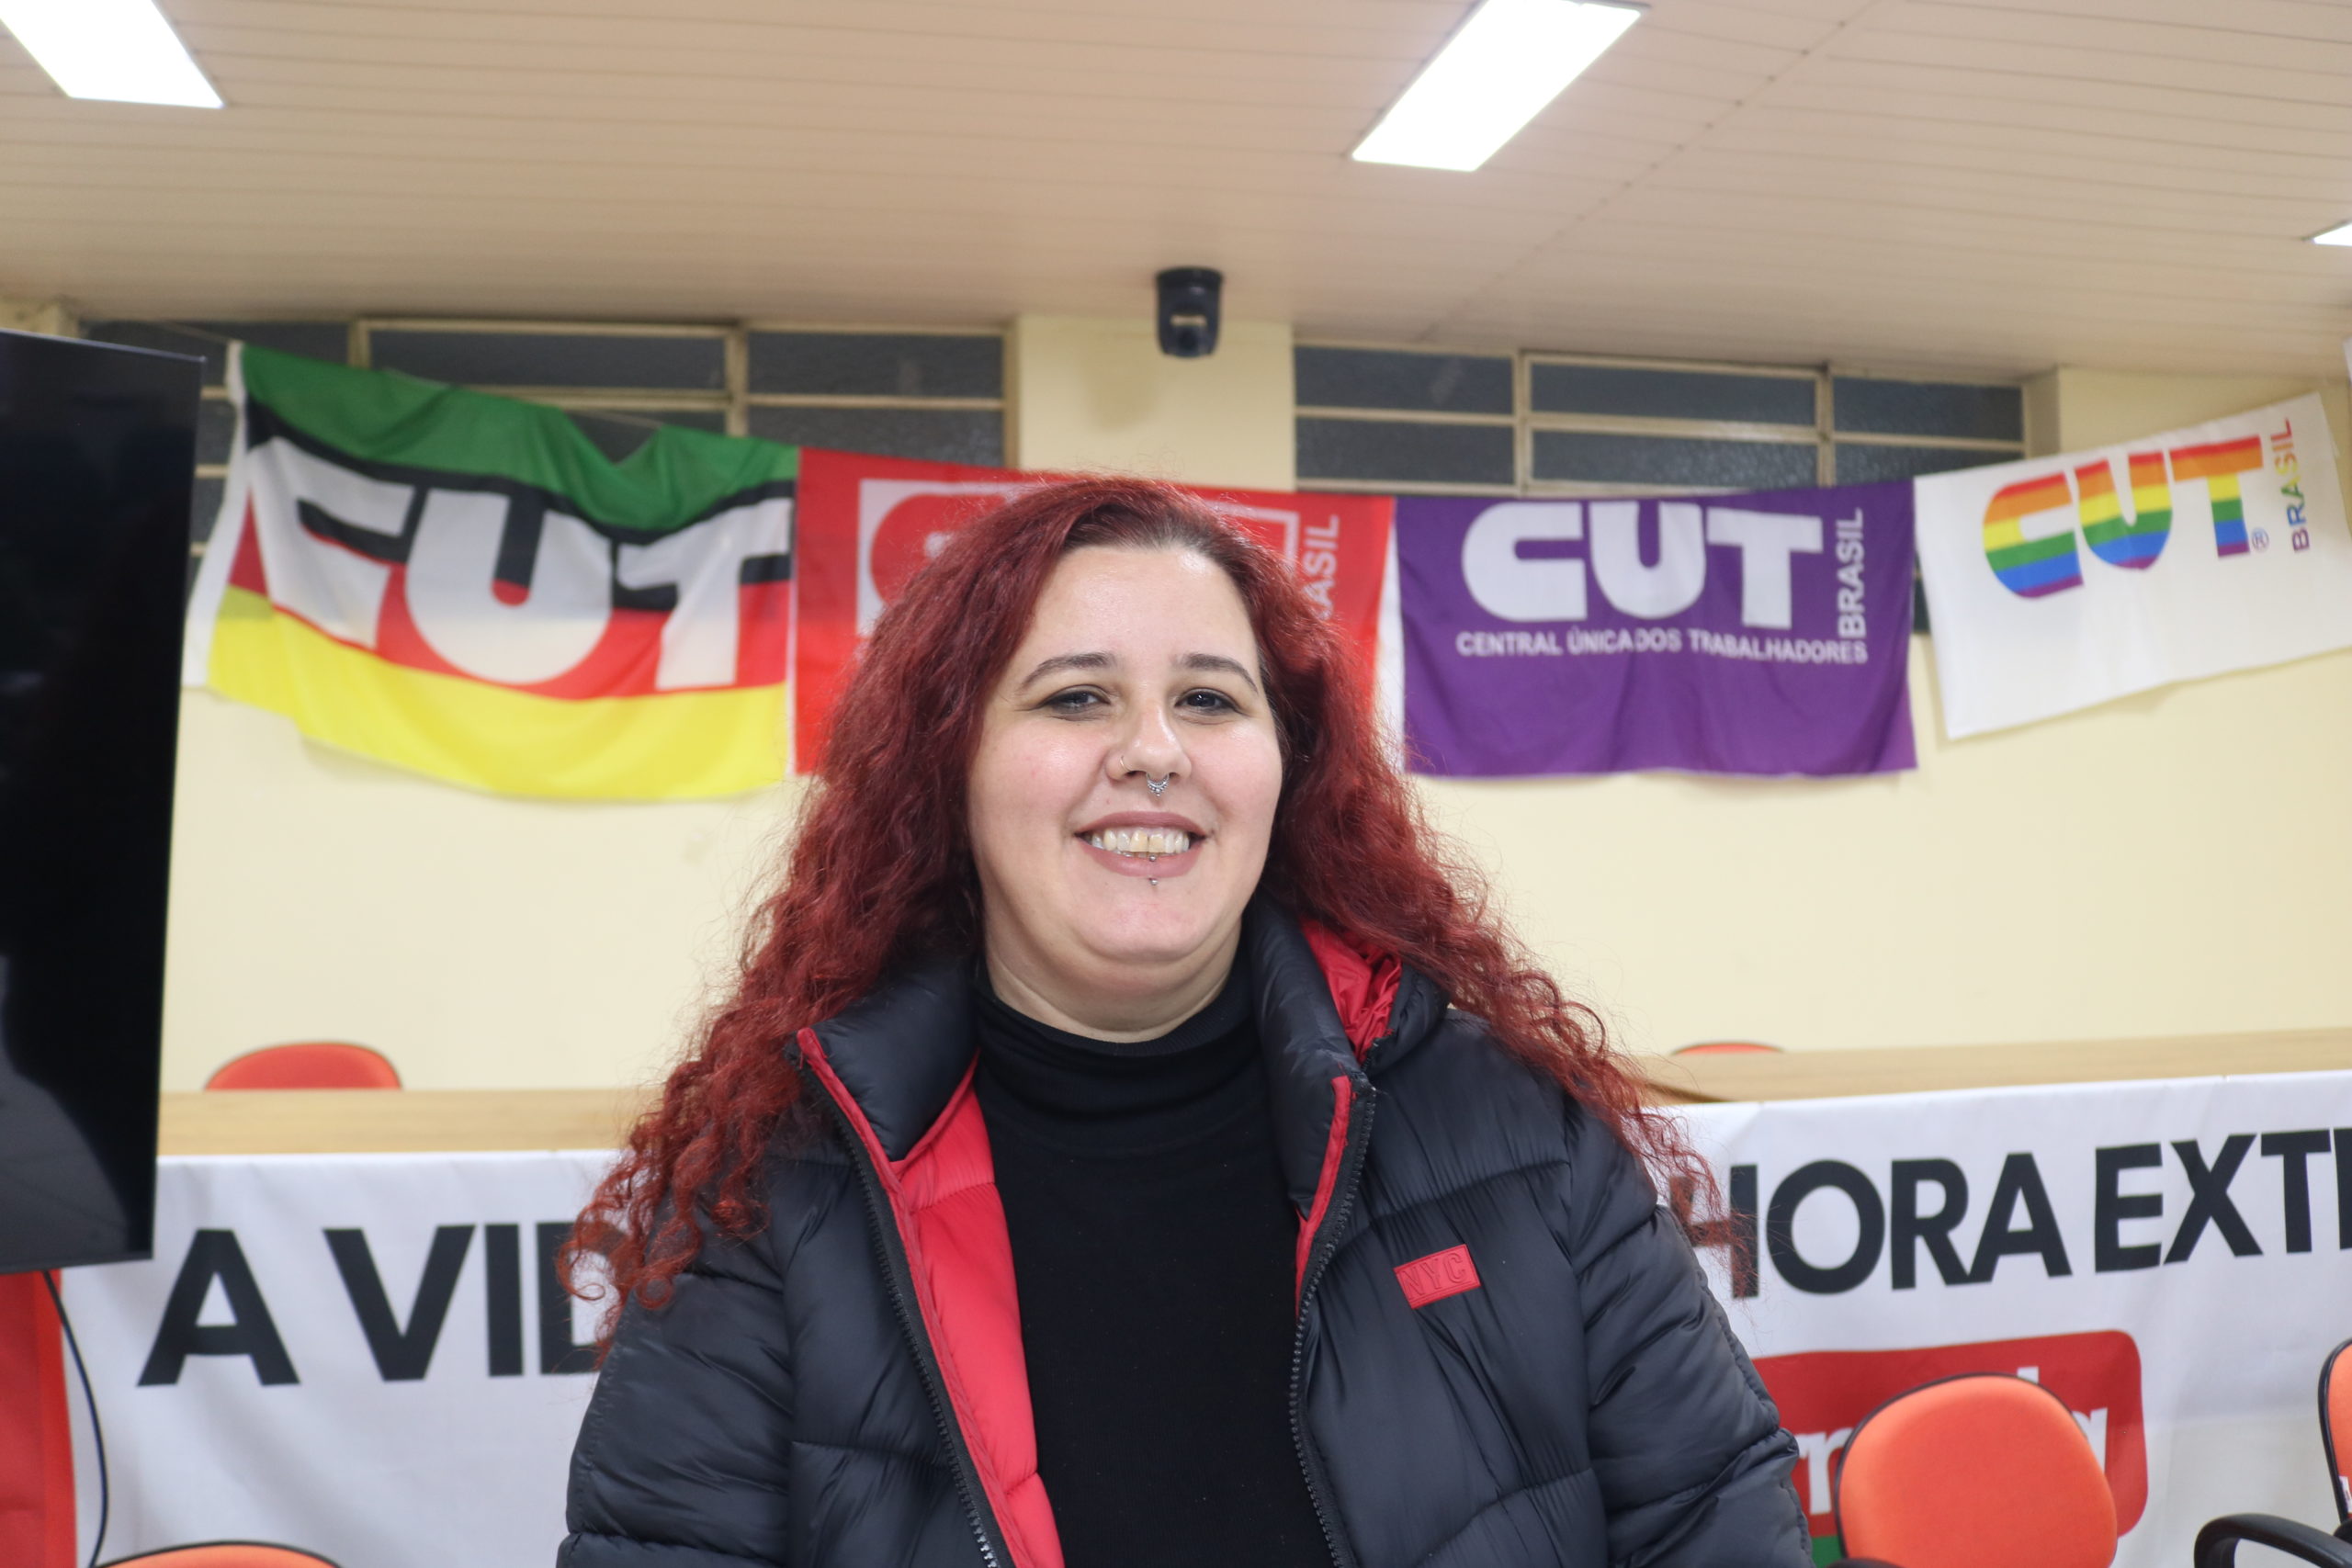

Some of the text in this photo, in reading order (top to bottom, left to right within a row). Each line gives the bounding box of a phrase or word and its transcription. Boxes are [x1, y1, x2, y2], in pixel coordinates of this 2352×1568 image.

[1981, 434, 2264, 600] CUT
[2269, 416, 2311, 553] BRASIL
[246, 436, 792, 691] CUT
[1461, 500, 1824, 630] CUT
[1835, 507, 1867, 638] BRASIL
[1455, 630, 1564, 658] CENTRAL
[1688, 627, 1869, 665] TRABALHADORES
[136, 1228, 301, 1387] A
[1668, 1151, 2074, 1299] HORA
[1398, 1251, 1469, 1301] NYC
